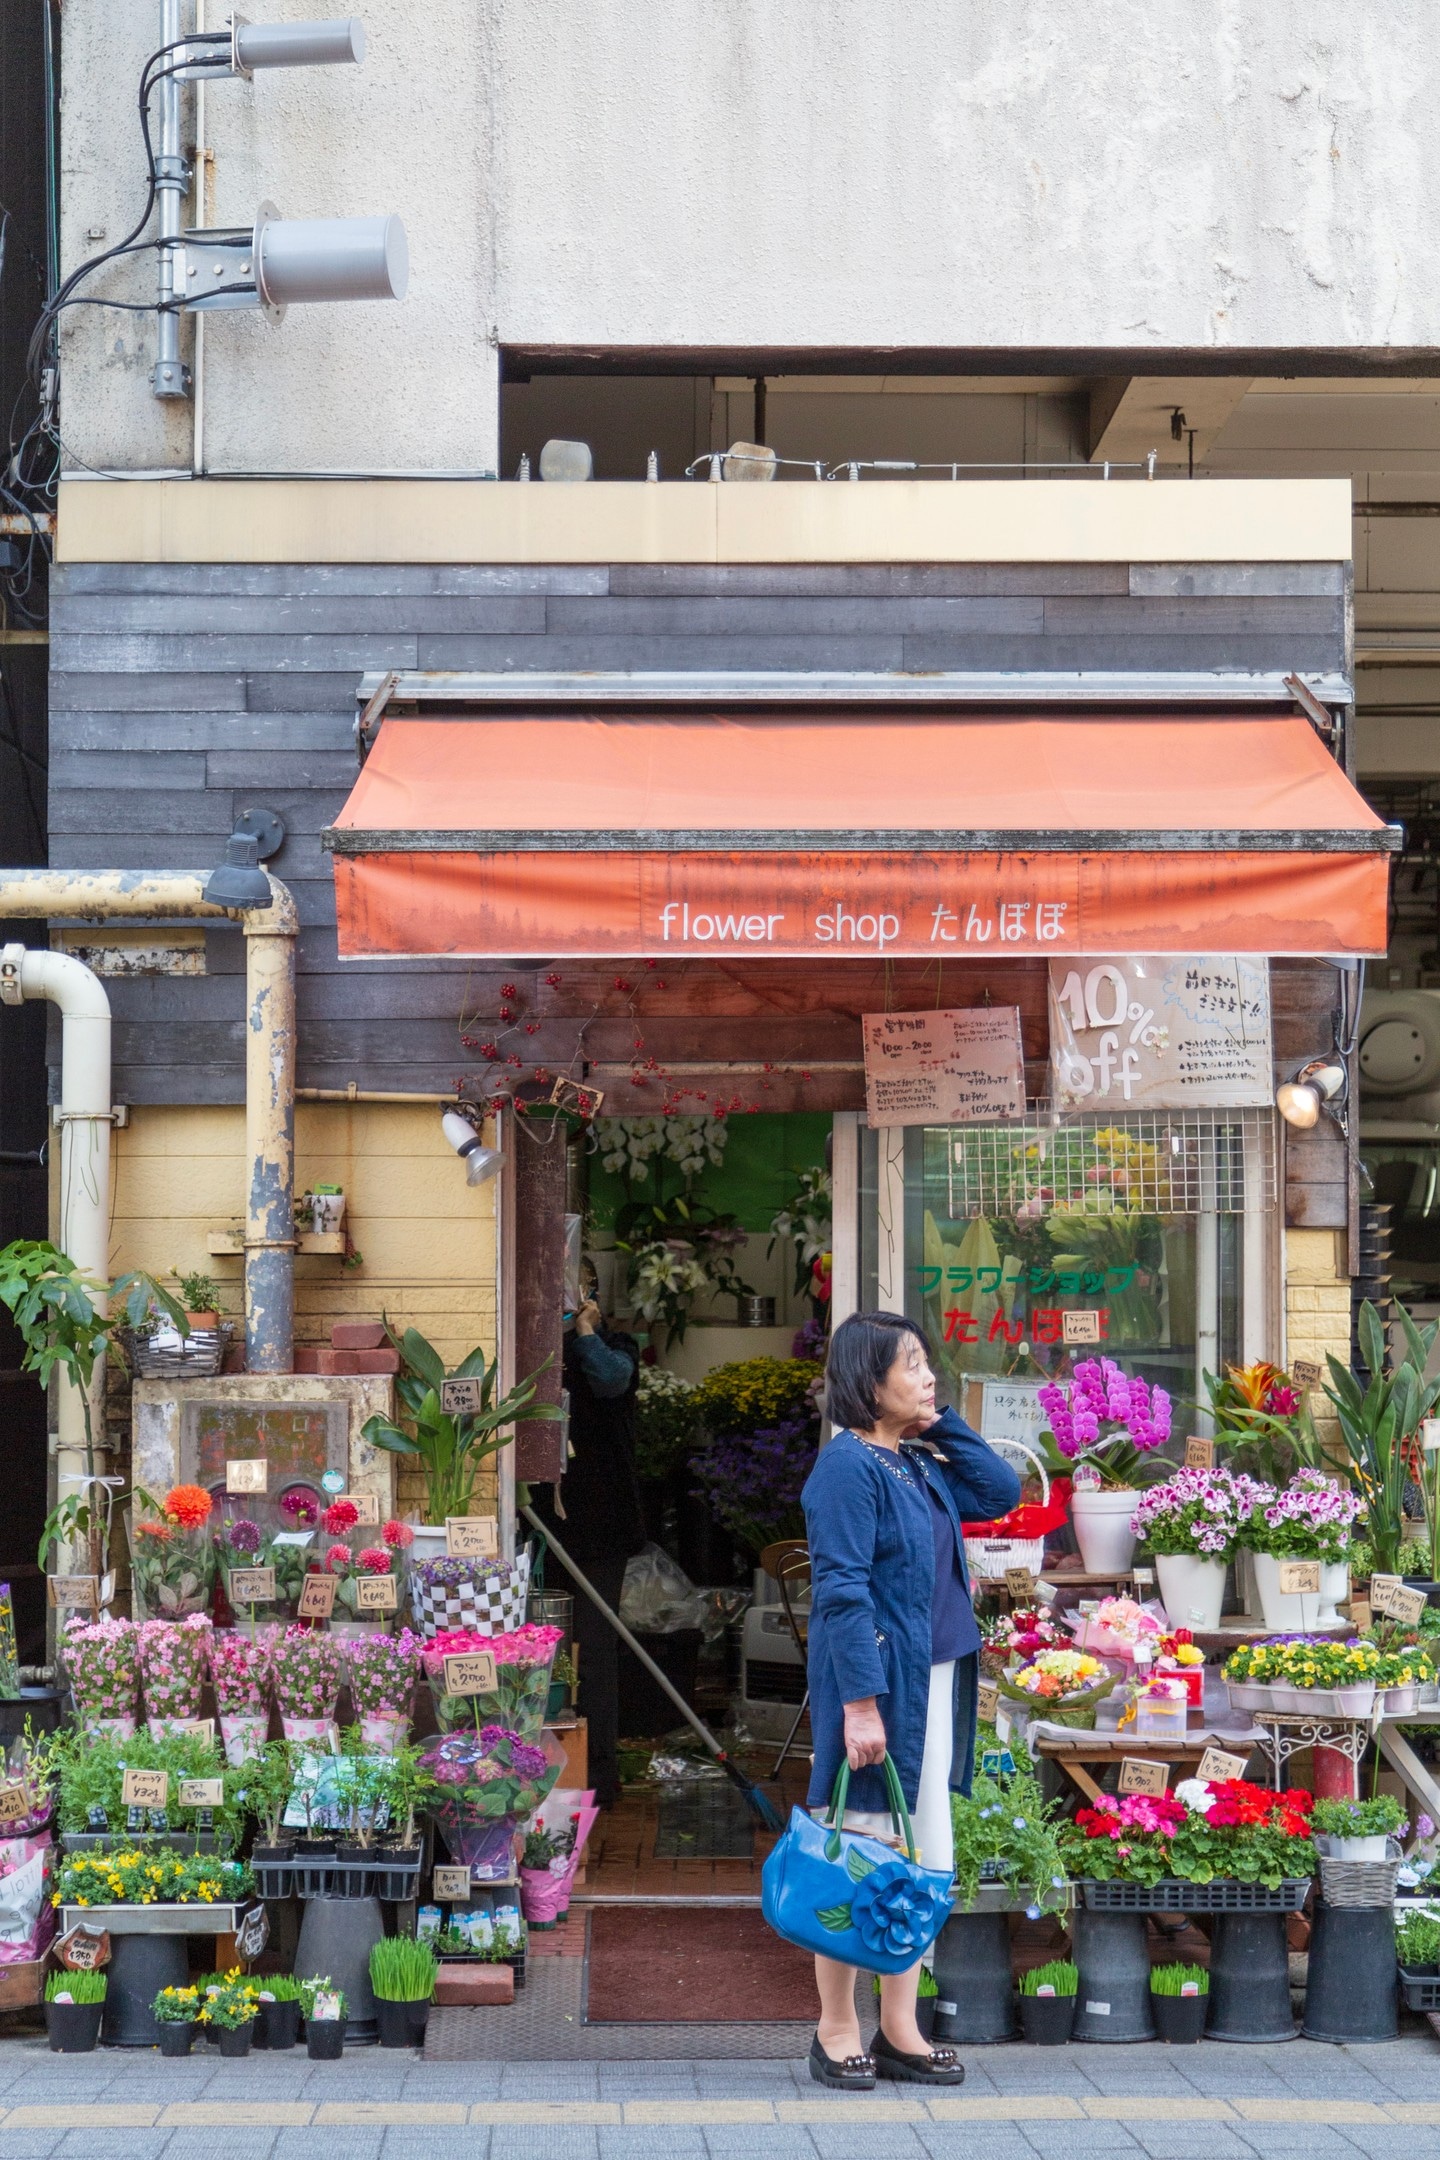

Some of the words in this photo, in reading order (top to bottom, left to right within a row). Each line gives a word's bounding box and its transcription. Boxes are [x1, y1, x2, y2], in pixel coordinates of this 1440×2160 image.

[659, 903, 784, 941] flower
[815, 903, 899, 950] shop
[930, 902, 1067, 941] たんぽぽ
[1058, 965, 1161, 1047] 10%
[1060, 1031, 1142, 1100] off
[915, 1263, 1141, 1296] フラワーショップ
[943, 1307, 1112, 1344] たんぽ
